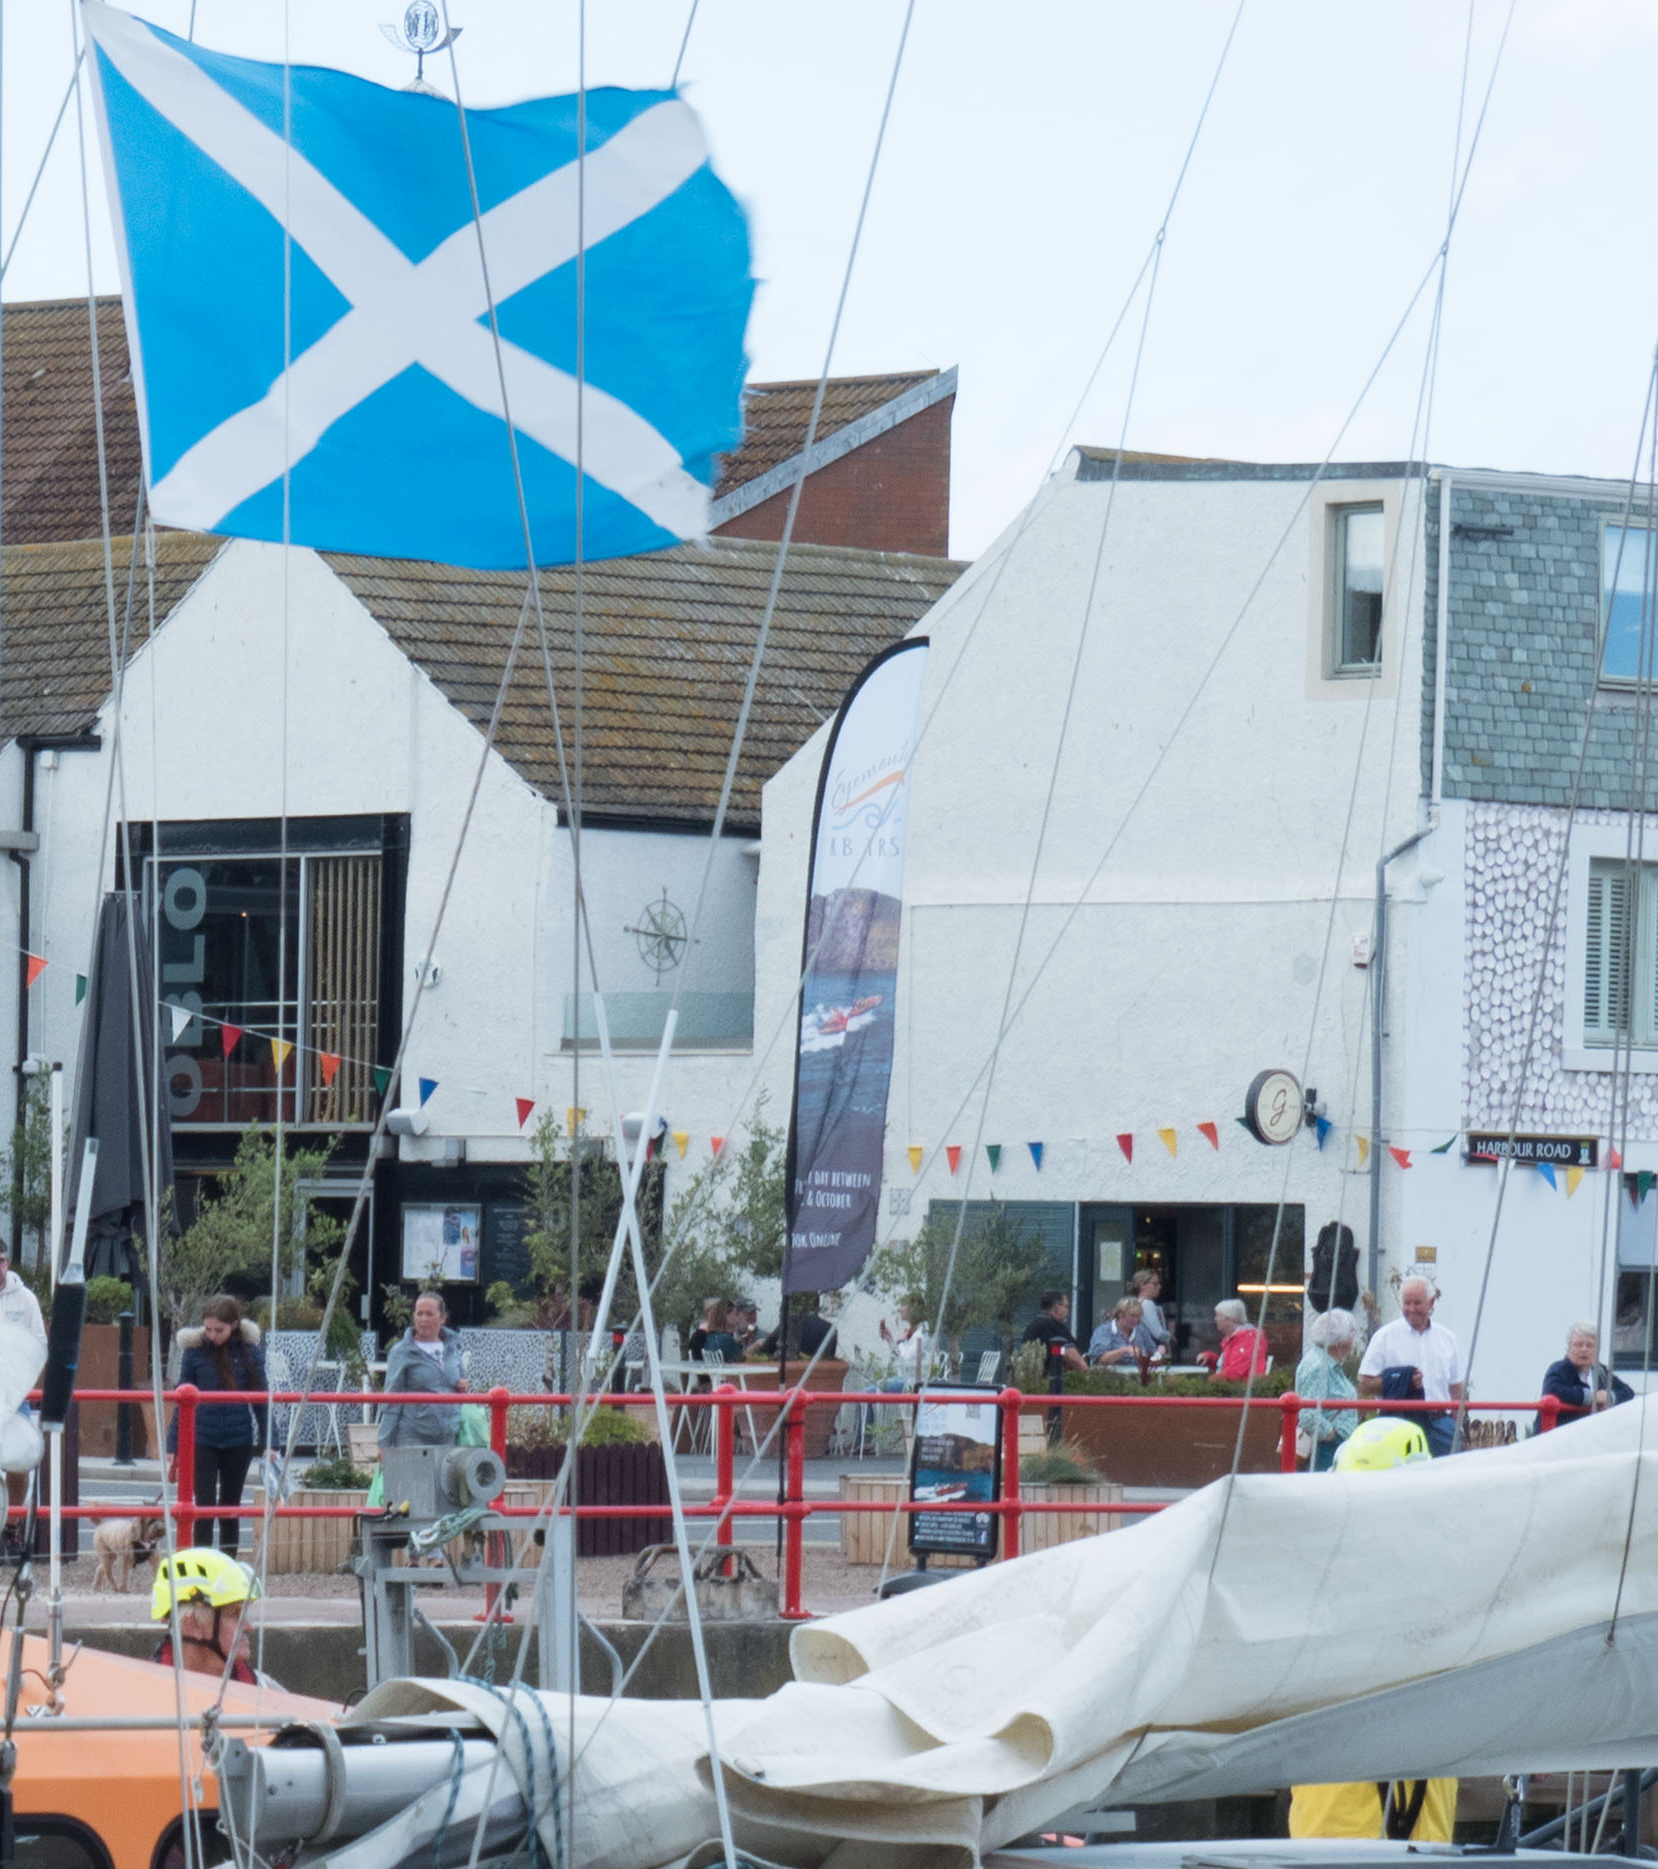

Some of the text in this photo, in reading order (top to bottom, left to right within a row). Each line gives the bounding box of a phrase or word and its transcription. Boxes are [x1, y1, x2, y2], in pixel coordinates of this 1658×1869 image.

[163, 867, 207, 1117] OBLO
[1536, 1143, 1571, 1159] ROAD
[831, 1171, 872, 1189] BETWEEN
[816, 1190, 852, 1209] OCTOBER
